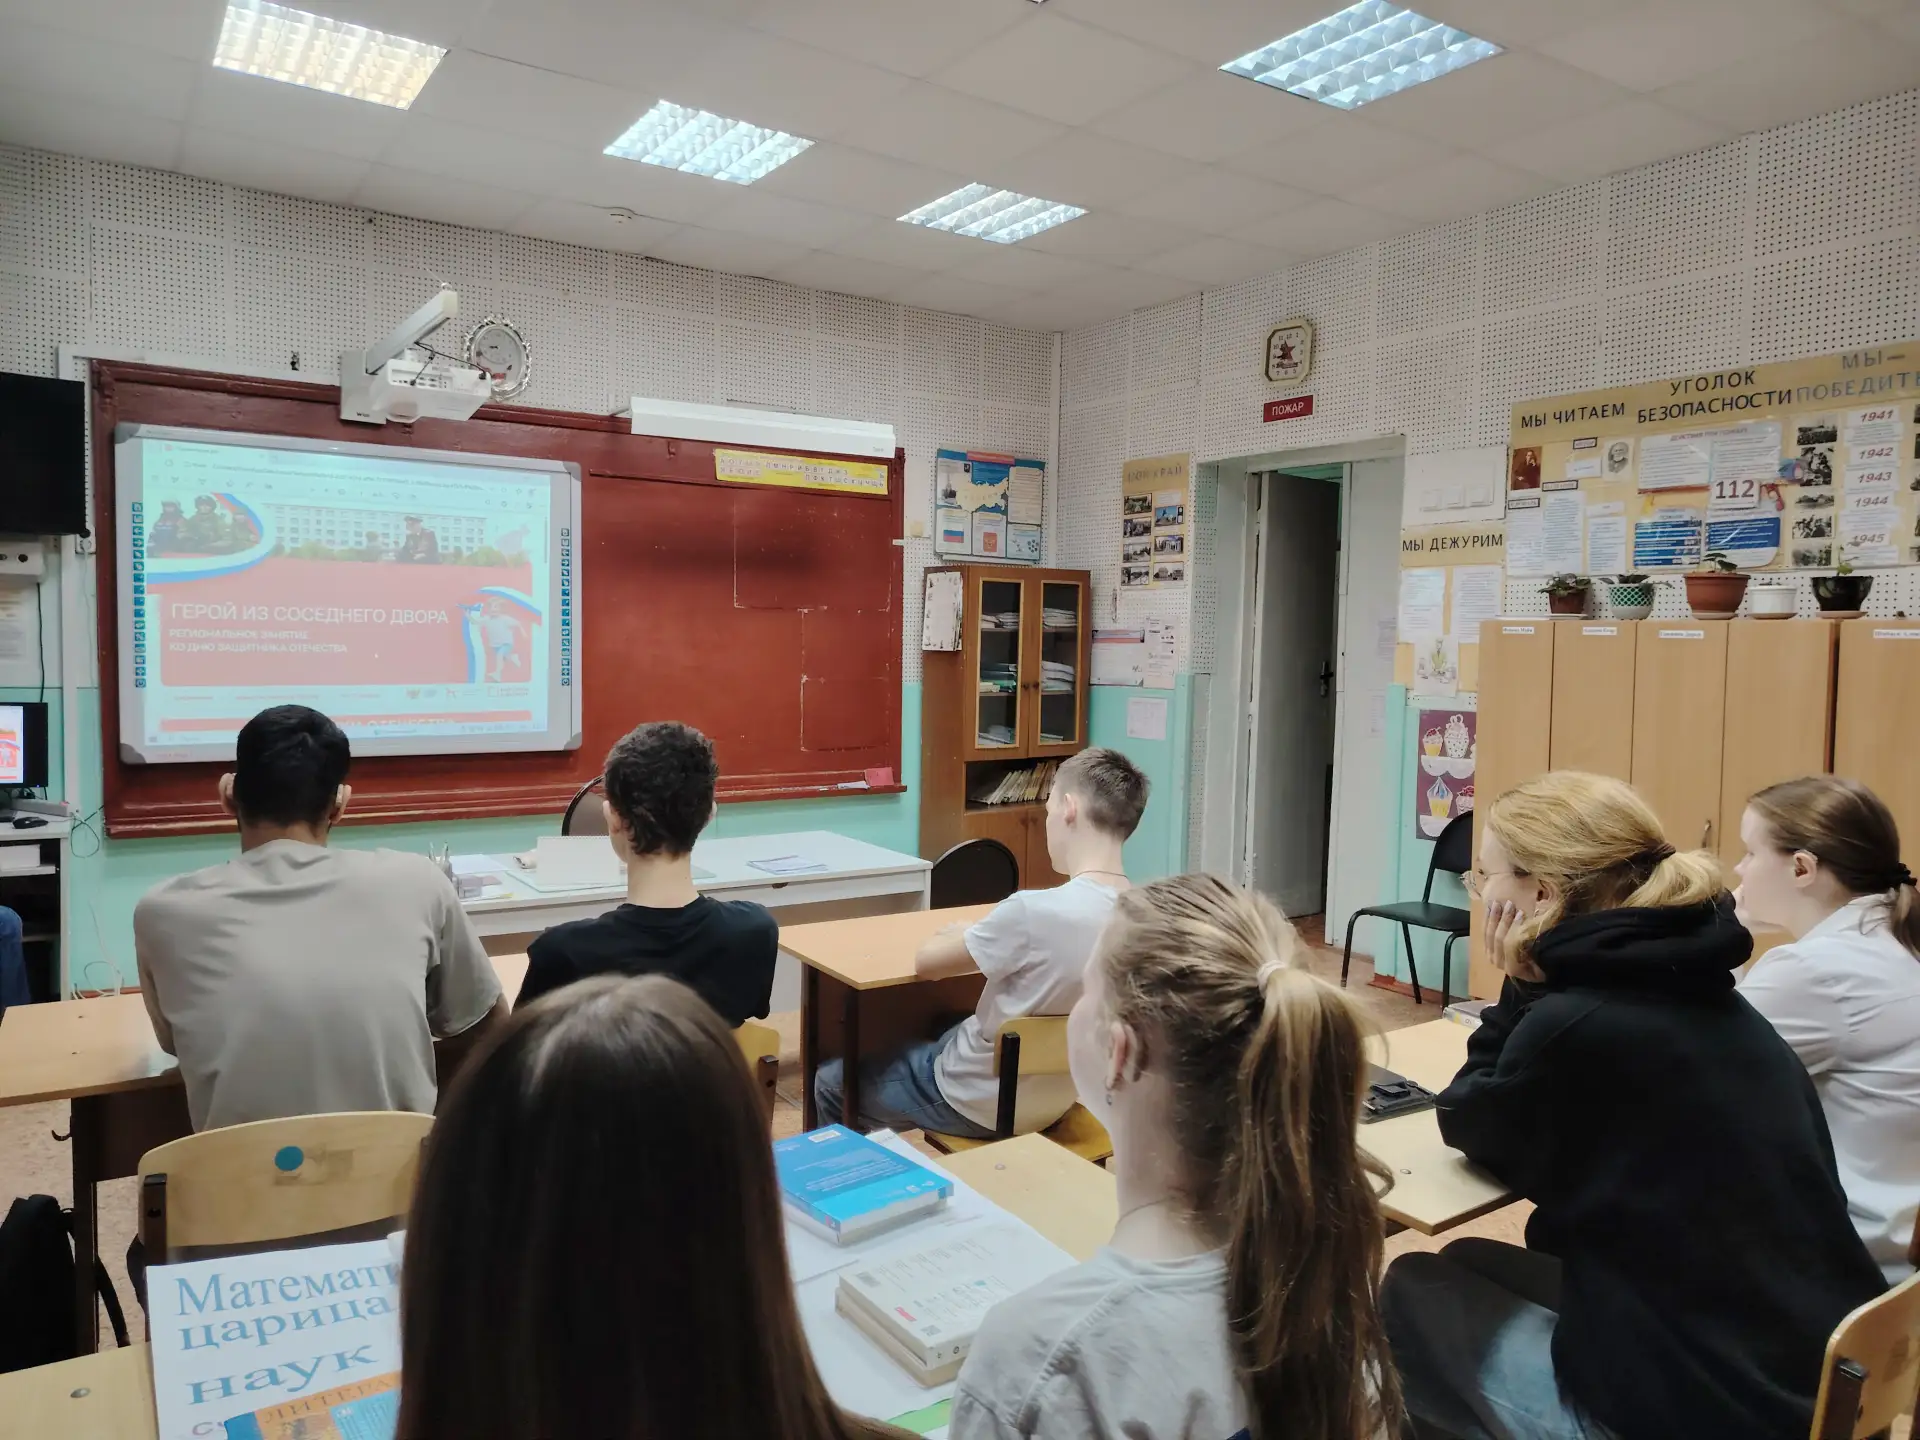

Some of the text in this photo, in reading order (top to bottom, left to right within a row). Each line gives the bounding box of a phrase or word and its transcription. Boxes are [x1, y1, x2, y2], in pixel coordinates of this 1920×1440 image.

[1842, 350, 1882, 370] МЫ
[1670, 370, 1756, 396] УГОЛОК
[1272, 401, 1304, 416] ПОЖАР
[1521, 402, 1625, 428] МЫ ЧИТАЕМ
[1637, 389, 1792, 424] БЕЗОПАСНОСТИ
[1860, 409, 1894, 422] 1941
[1859, 447, 1894, 459] 1942
[1858, 471, 1893, 483] 1943
[1715, 479, 1755, 499] 112
[1854, 496, 1890, 508] 1944
[1402, 533, 1503, 552] МЫ ДЕЖУРИМ
[1852, 533, 1886, 544] 1945
[171, 602, 449, 625] ГЕРОЙ ИЗ СОСЕДНЕГО ДВОРА
[288, 643, 347, 653] ОТЕЧЕСТВА
[180, 1295, 397, 1351] царица
[187, 1345, 379, 1405] наук
